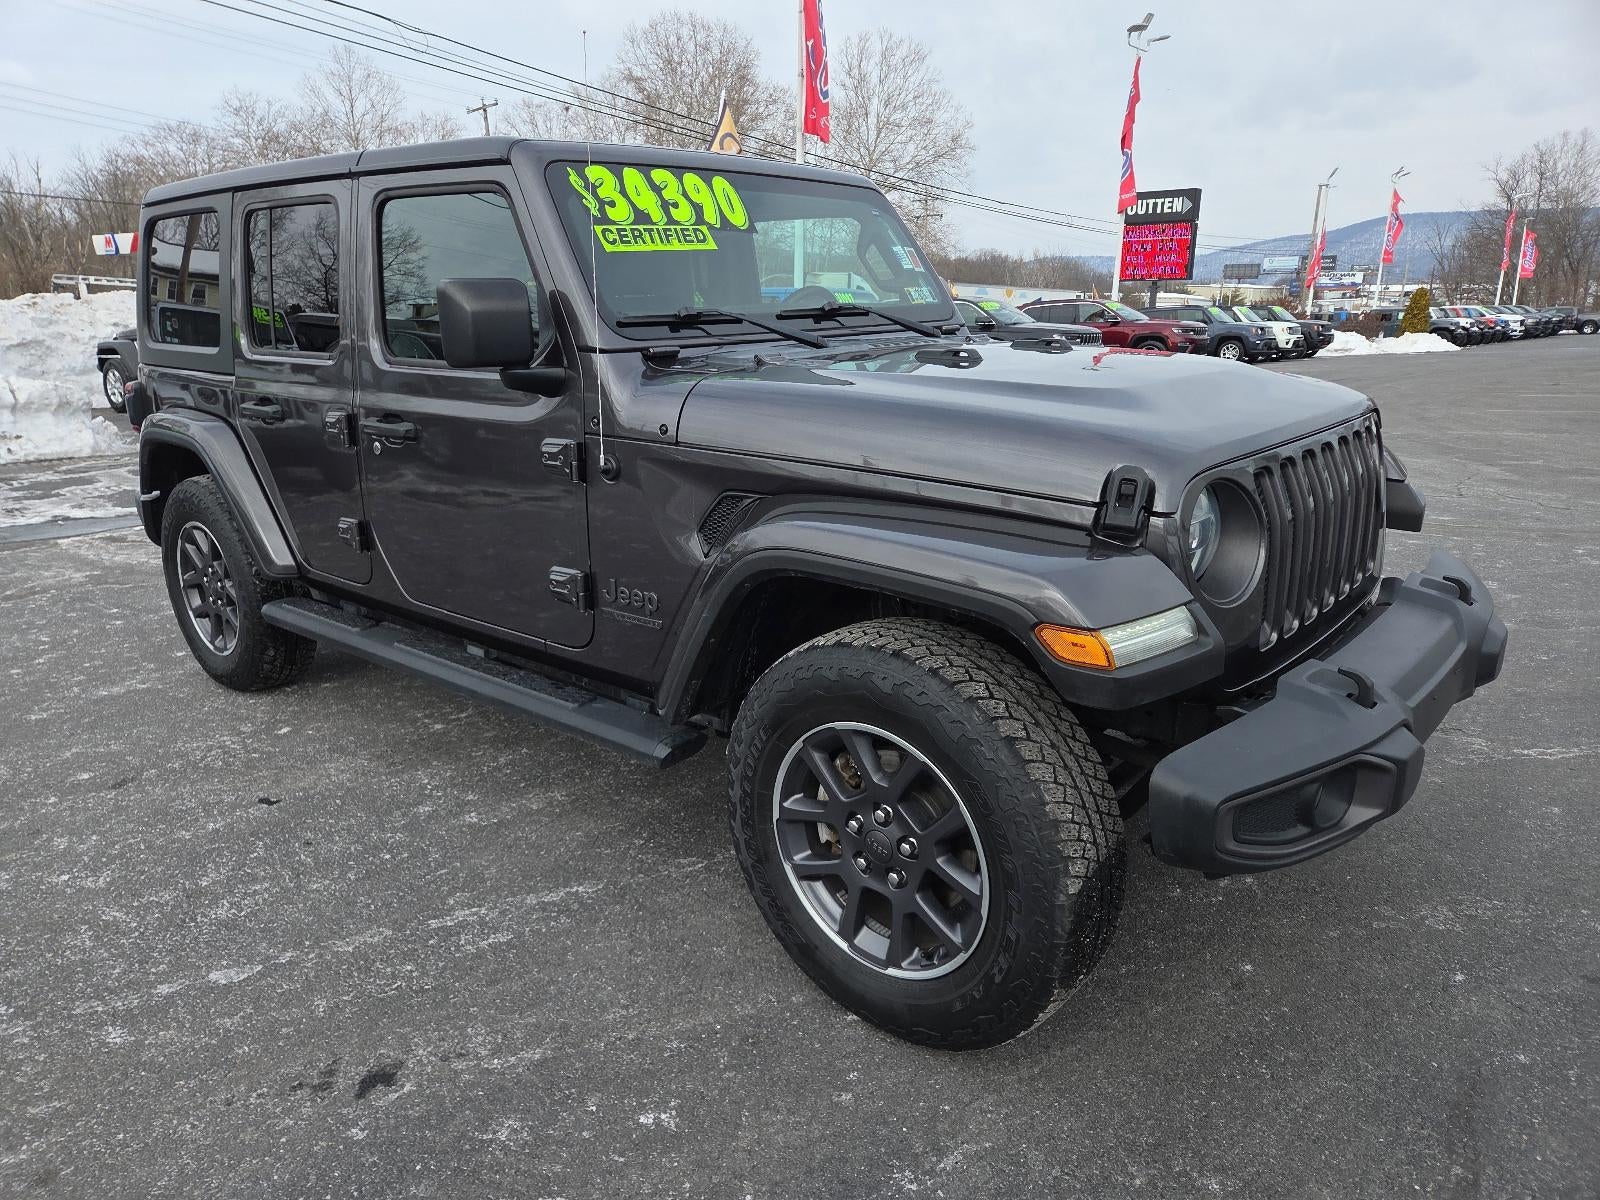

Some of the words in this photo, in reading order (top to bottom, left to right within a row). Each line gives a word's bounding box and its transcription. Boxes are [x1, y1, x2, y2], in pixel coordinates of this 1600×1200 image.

[566, 164, 750, 231] $34390
[601, 226, 710, 248] CERTIFIED
[600, 577, 659, 617] Jeep
